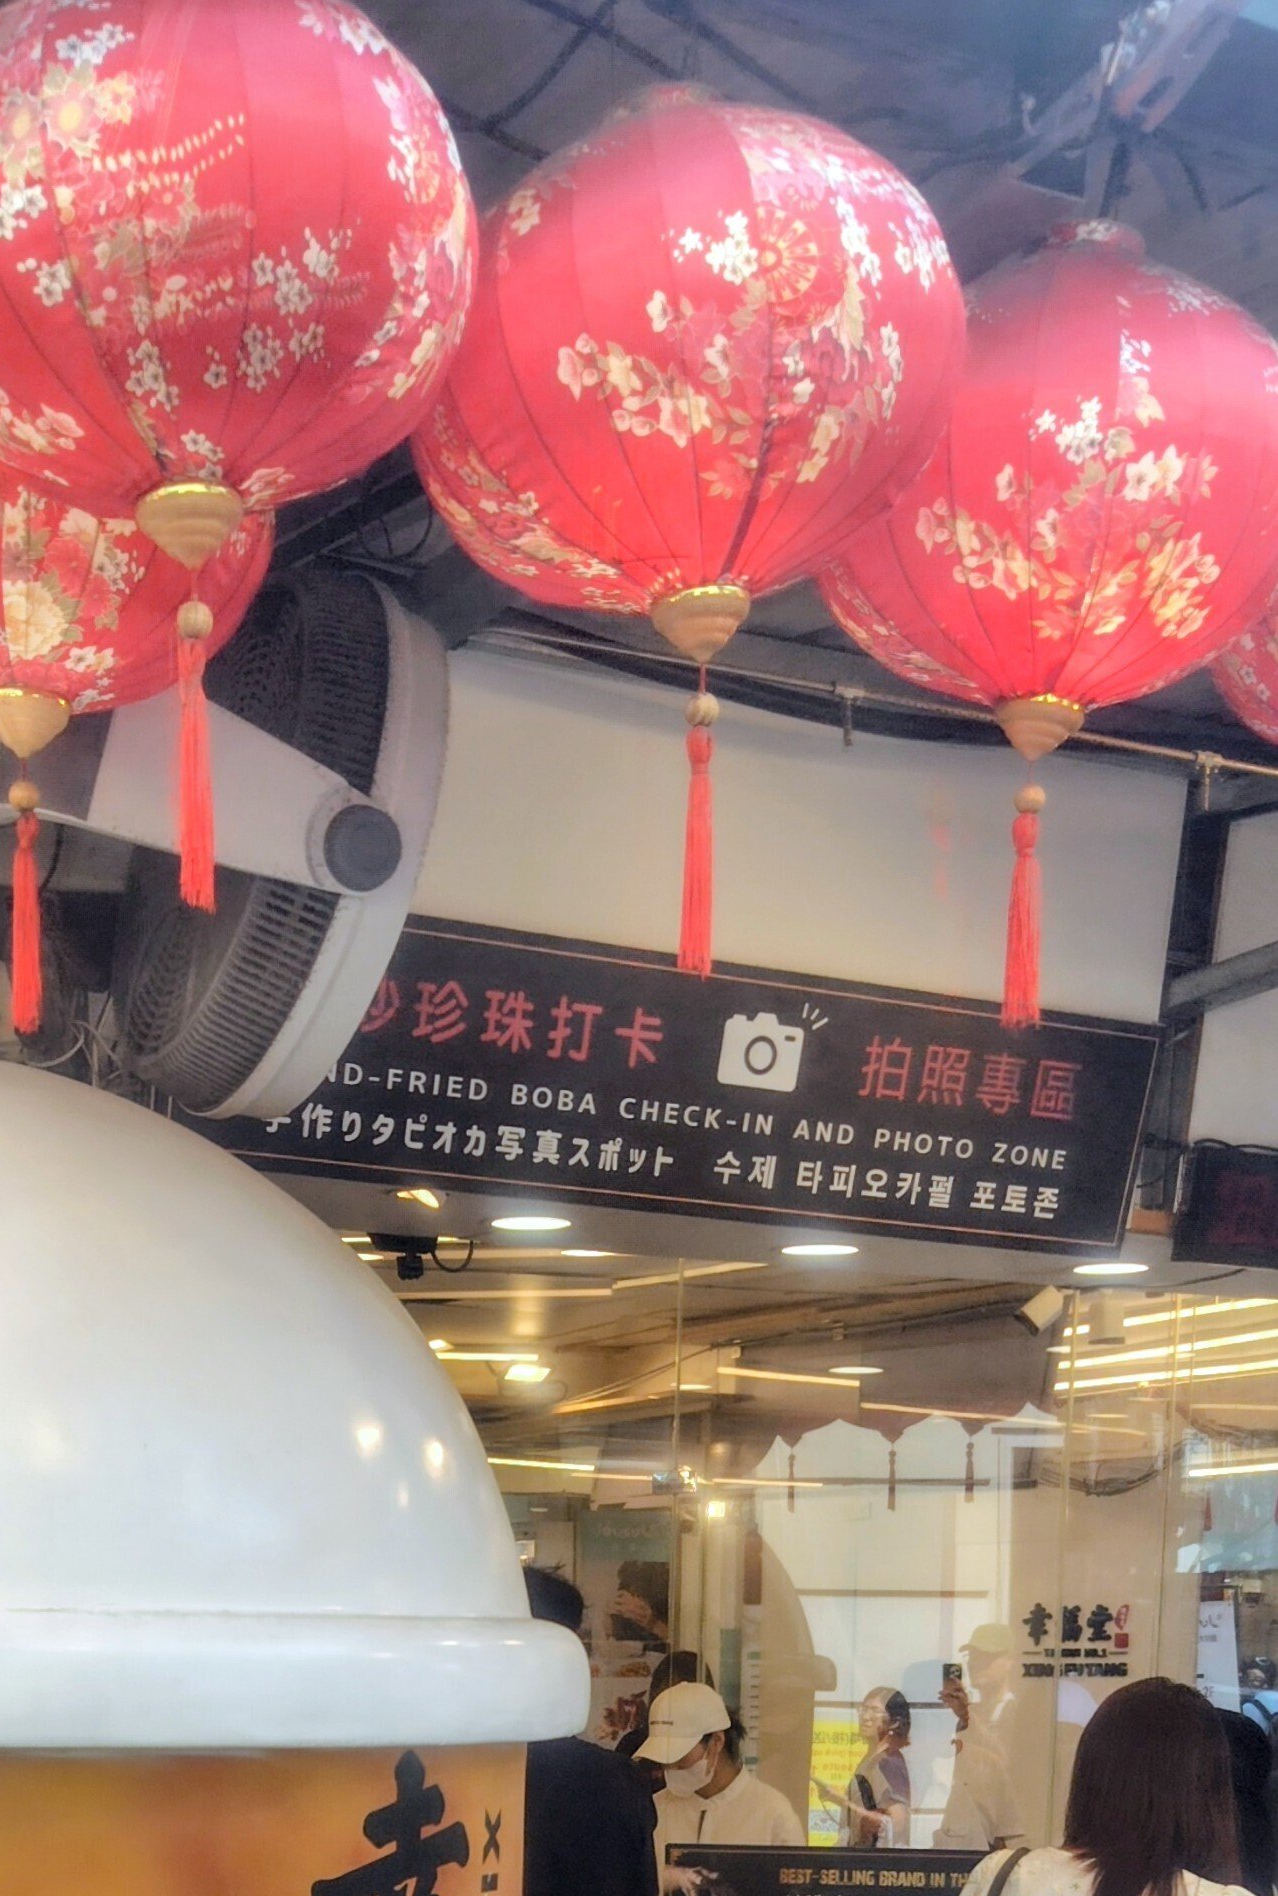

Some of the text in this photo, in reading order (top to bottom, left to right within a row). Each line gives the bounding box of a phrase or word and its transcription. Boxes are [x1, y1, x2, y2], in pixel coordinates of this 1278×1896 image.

[858, 1035, 1082, 1120] 拍照專區
[510, 1083, 597, 1116] BOBA
[618, 1097, 774, 1137] CHECK-IN
[792, 1118, 855, 1146] AND
[873, 1128, 974, 1159] PHOTO
[991, 1142, 1068, 1171] ZONE
[713, 1150, 1060, 1220] 수제 타피오카펄 포토존
[779, 1868, 945, 1888] BEST-SELLING BRAND IN
